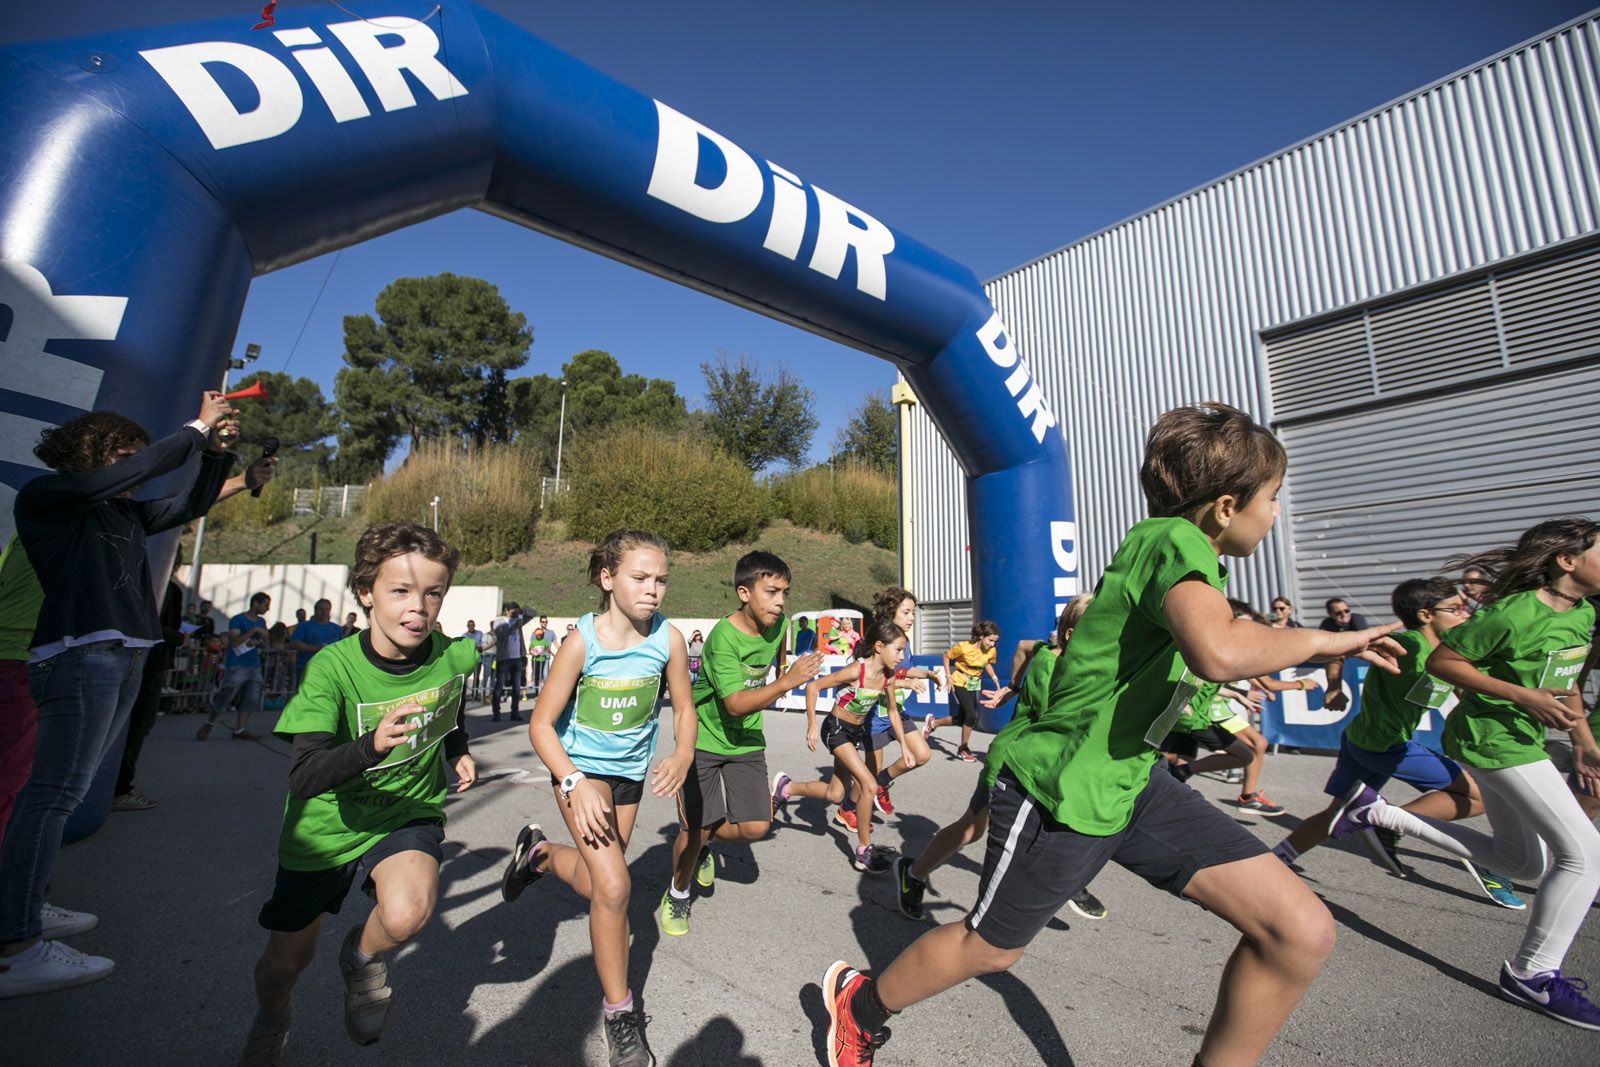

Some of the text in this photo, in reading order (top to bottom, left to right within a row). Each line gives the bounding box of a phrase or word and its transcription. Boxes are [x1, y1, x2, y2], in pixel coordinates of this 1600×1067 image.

[600, 696, 638, 709] UMA
[411, 705, 445, 729] ARC
[612, 712, 623, 726] 9
